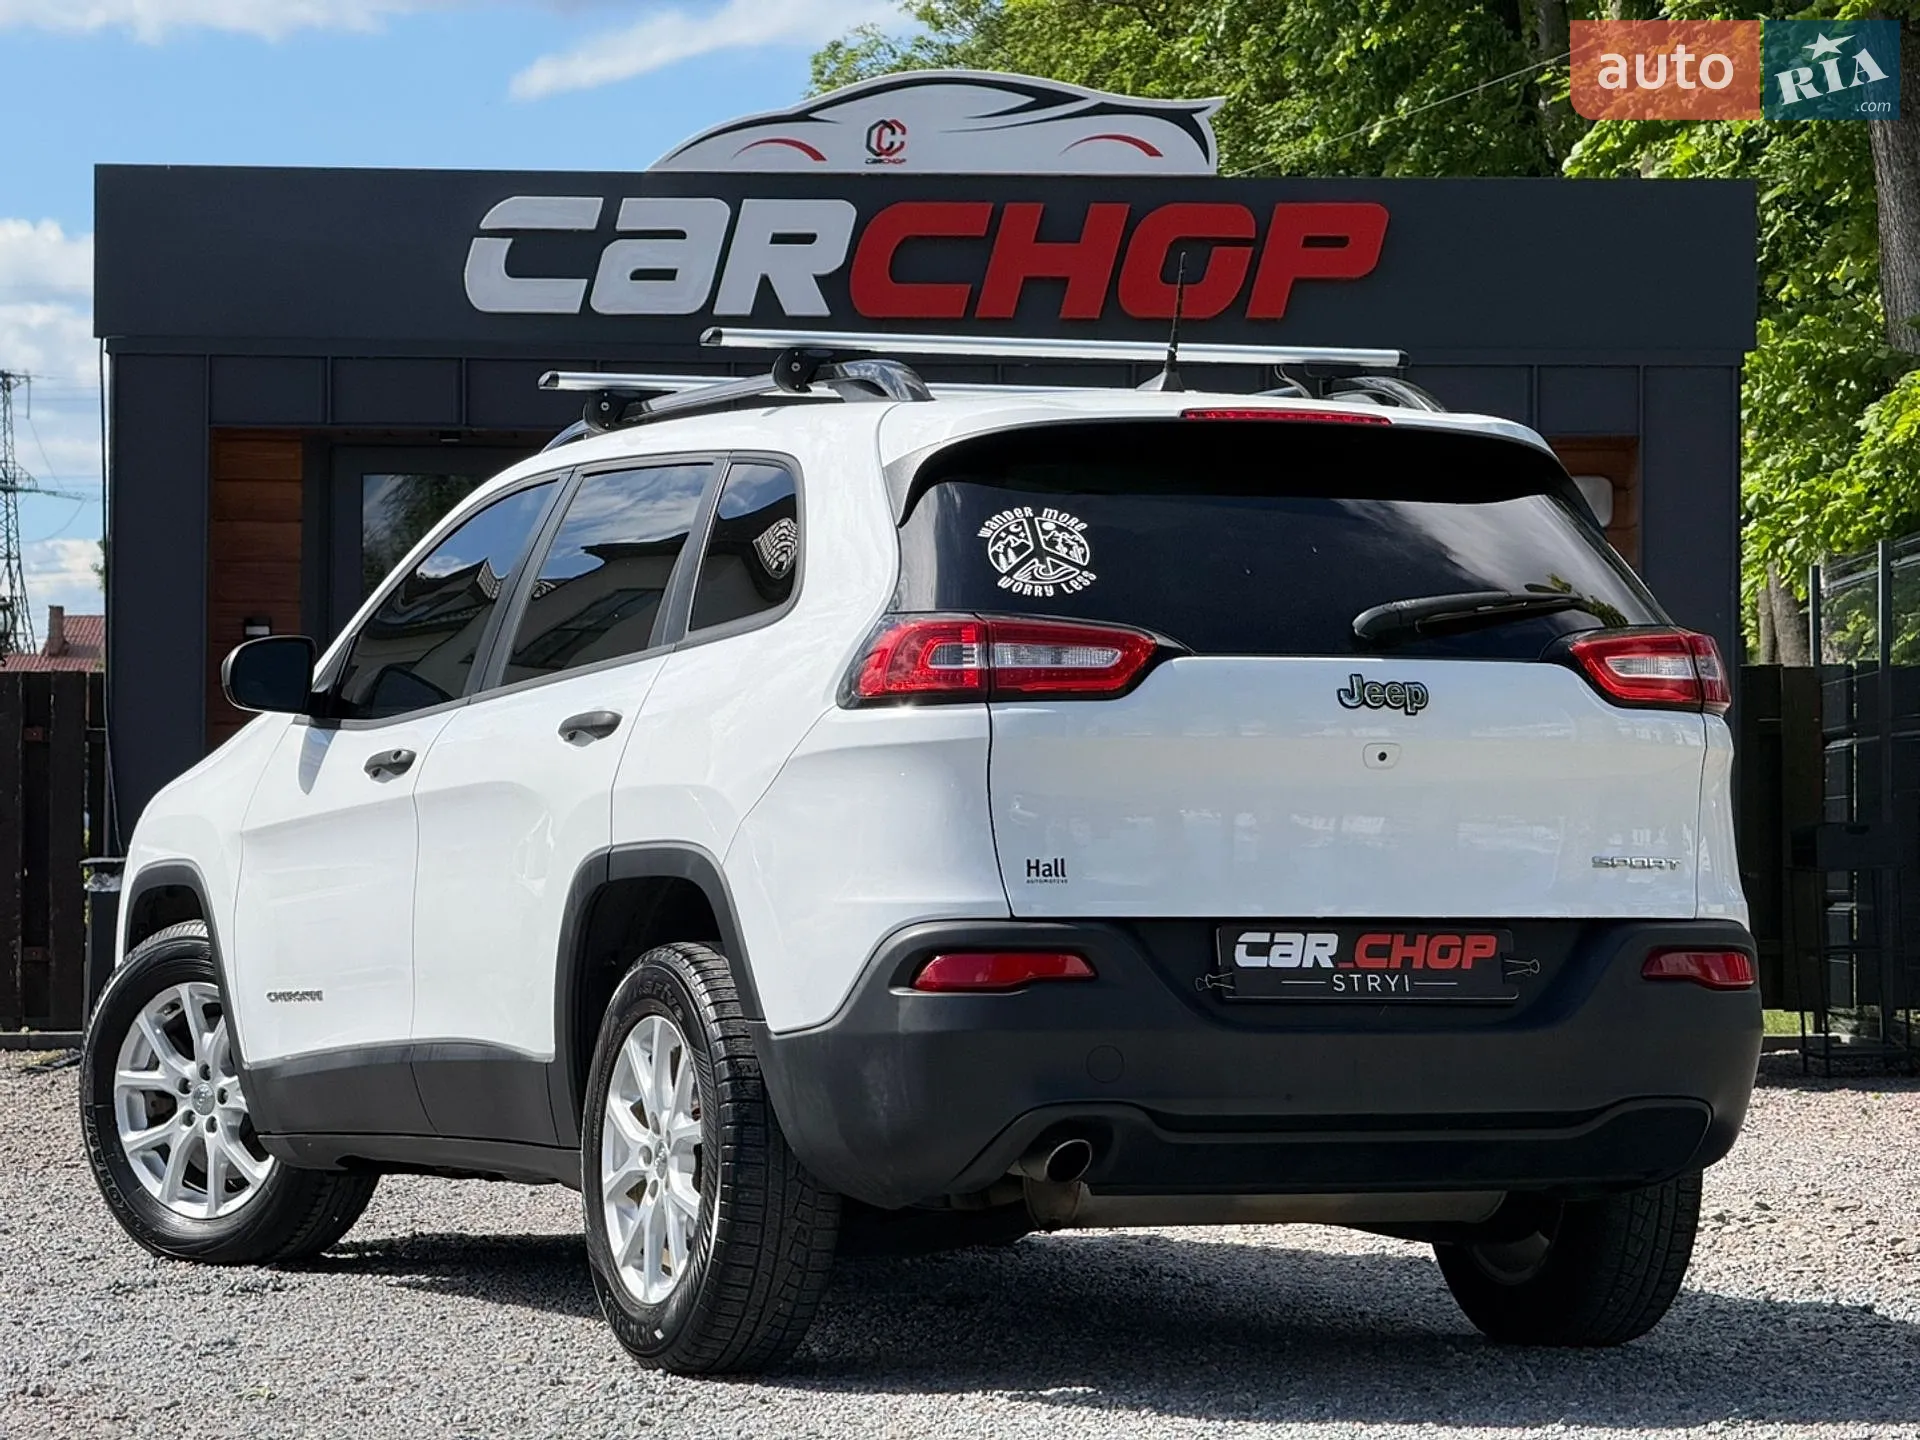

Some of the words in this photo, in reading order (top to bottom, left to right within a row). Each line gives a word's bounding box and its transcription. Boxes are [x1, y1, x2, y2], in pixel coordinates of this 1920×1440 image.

[1337, 673, 1430, 716] Jeep
[1026, 857, 1067, 878] Hall
[1591, 855, 1681, 870] SPORT
[1332, 973, 1411, 993] STRYI
